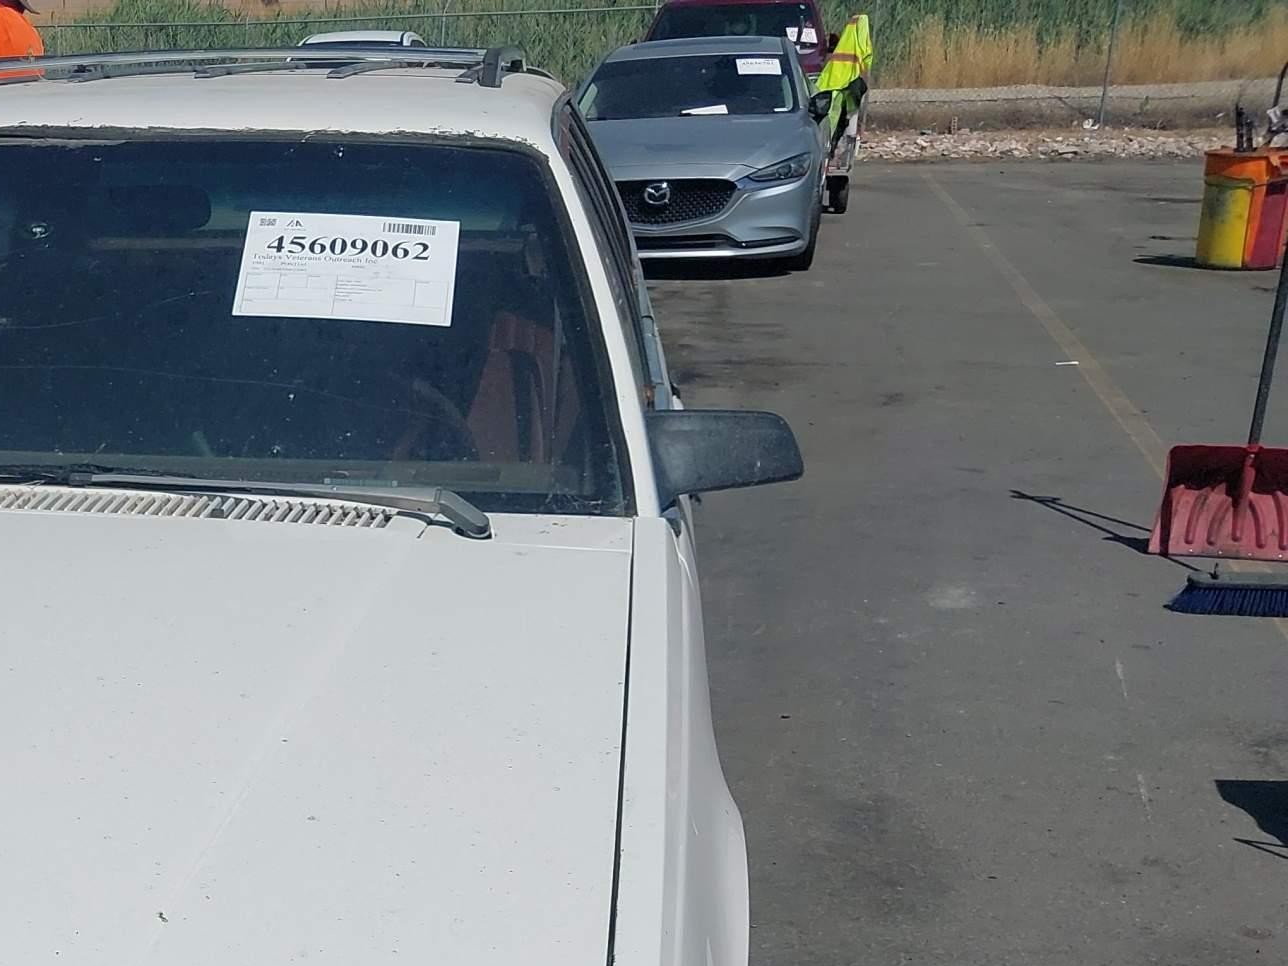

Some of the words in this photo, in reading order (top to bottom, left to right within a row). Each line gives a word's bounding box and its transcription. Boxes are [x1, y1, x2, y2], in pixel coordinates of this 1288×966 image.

[267, 235, 430, 261] 45609062
[285, 254, 322, 262] Veterans
[324, 255, 362, 264] Outreach
